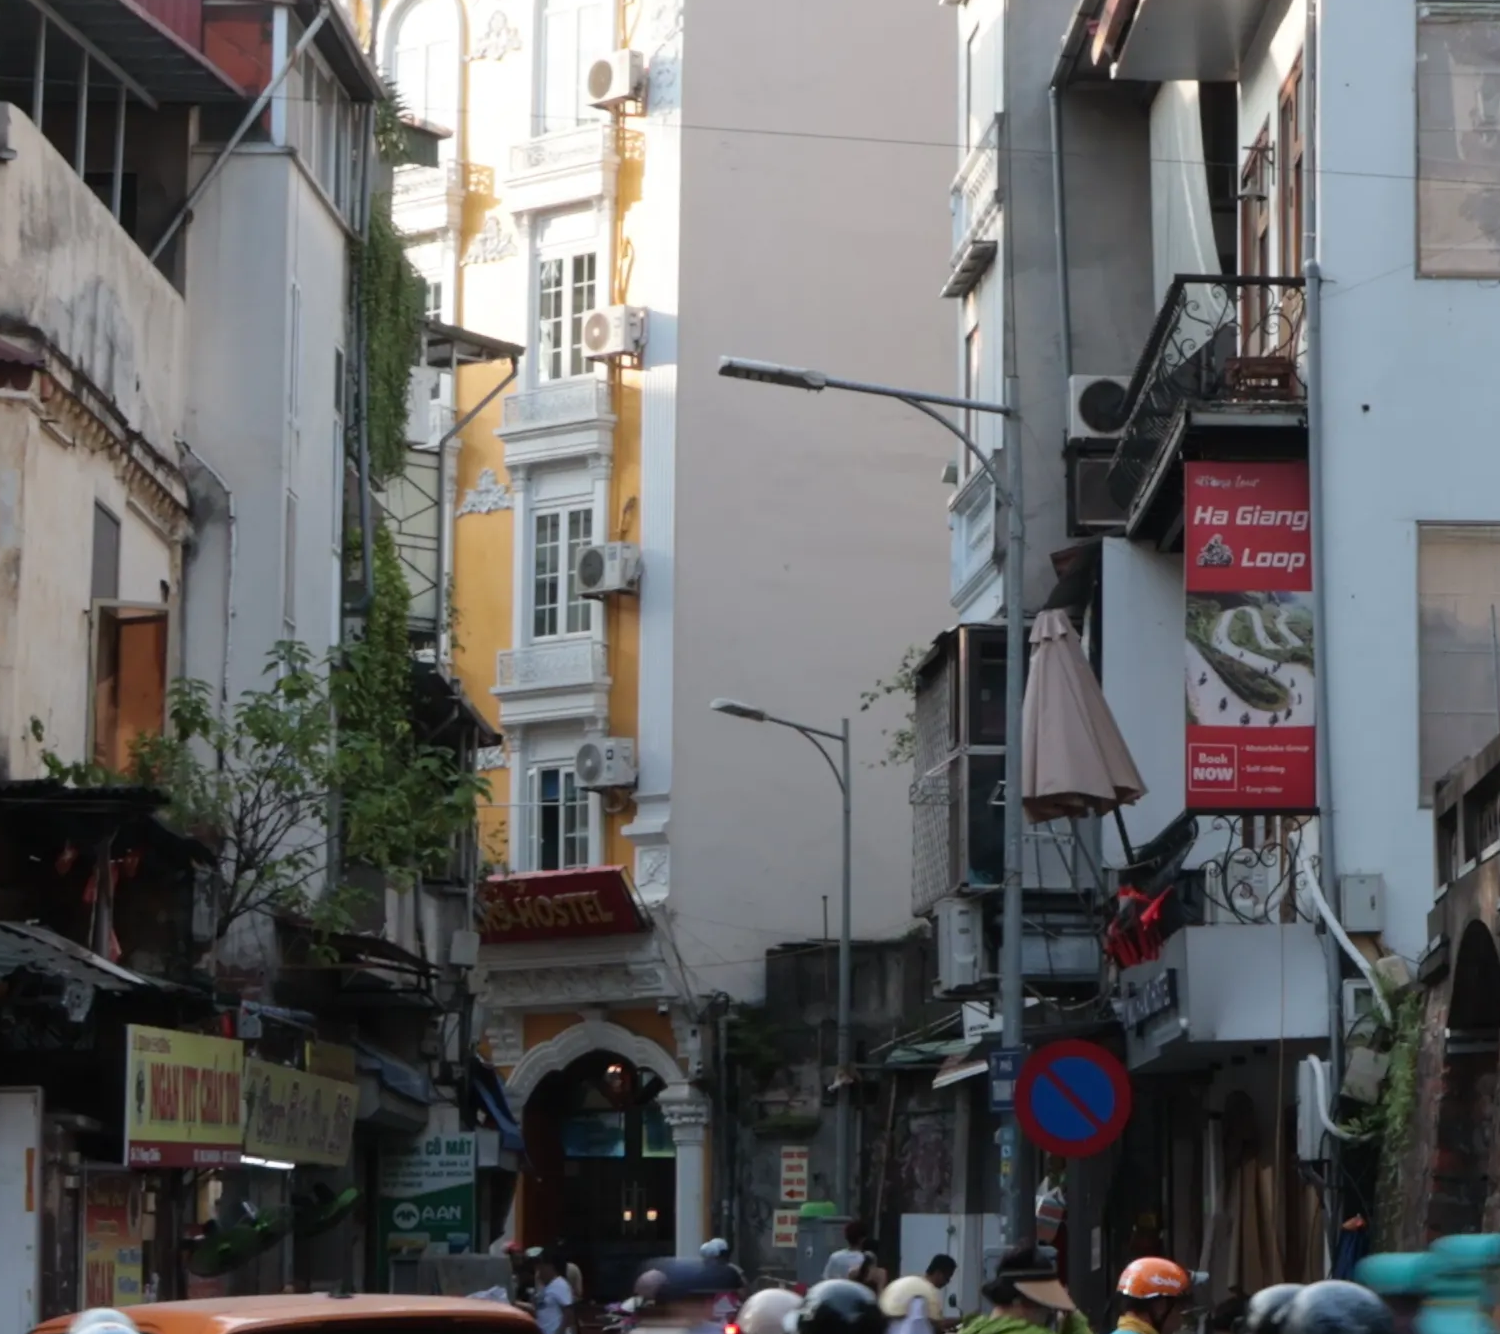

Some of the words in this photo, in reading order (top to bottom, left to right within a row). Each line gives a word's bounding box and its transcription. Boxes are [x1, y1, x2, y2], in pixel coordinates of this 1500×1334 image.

[1193, 505, 1229, 526] Ha
[1235, 505, 1310, 531] Giang
[1240, 547, 1306, 573] Loop
[1198, 752, 1228, 764] Book
[1192, 766, 1234, 781] NOW
